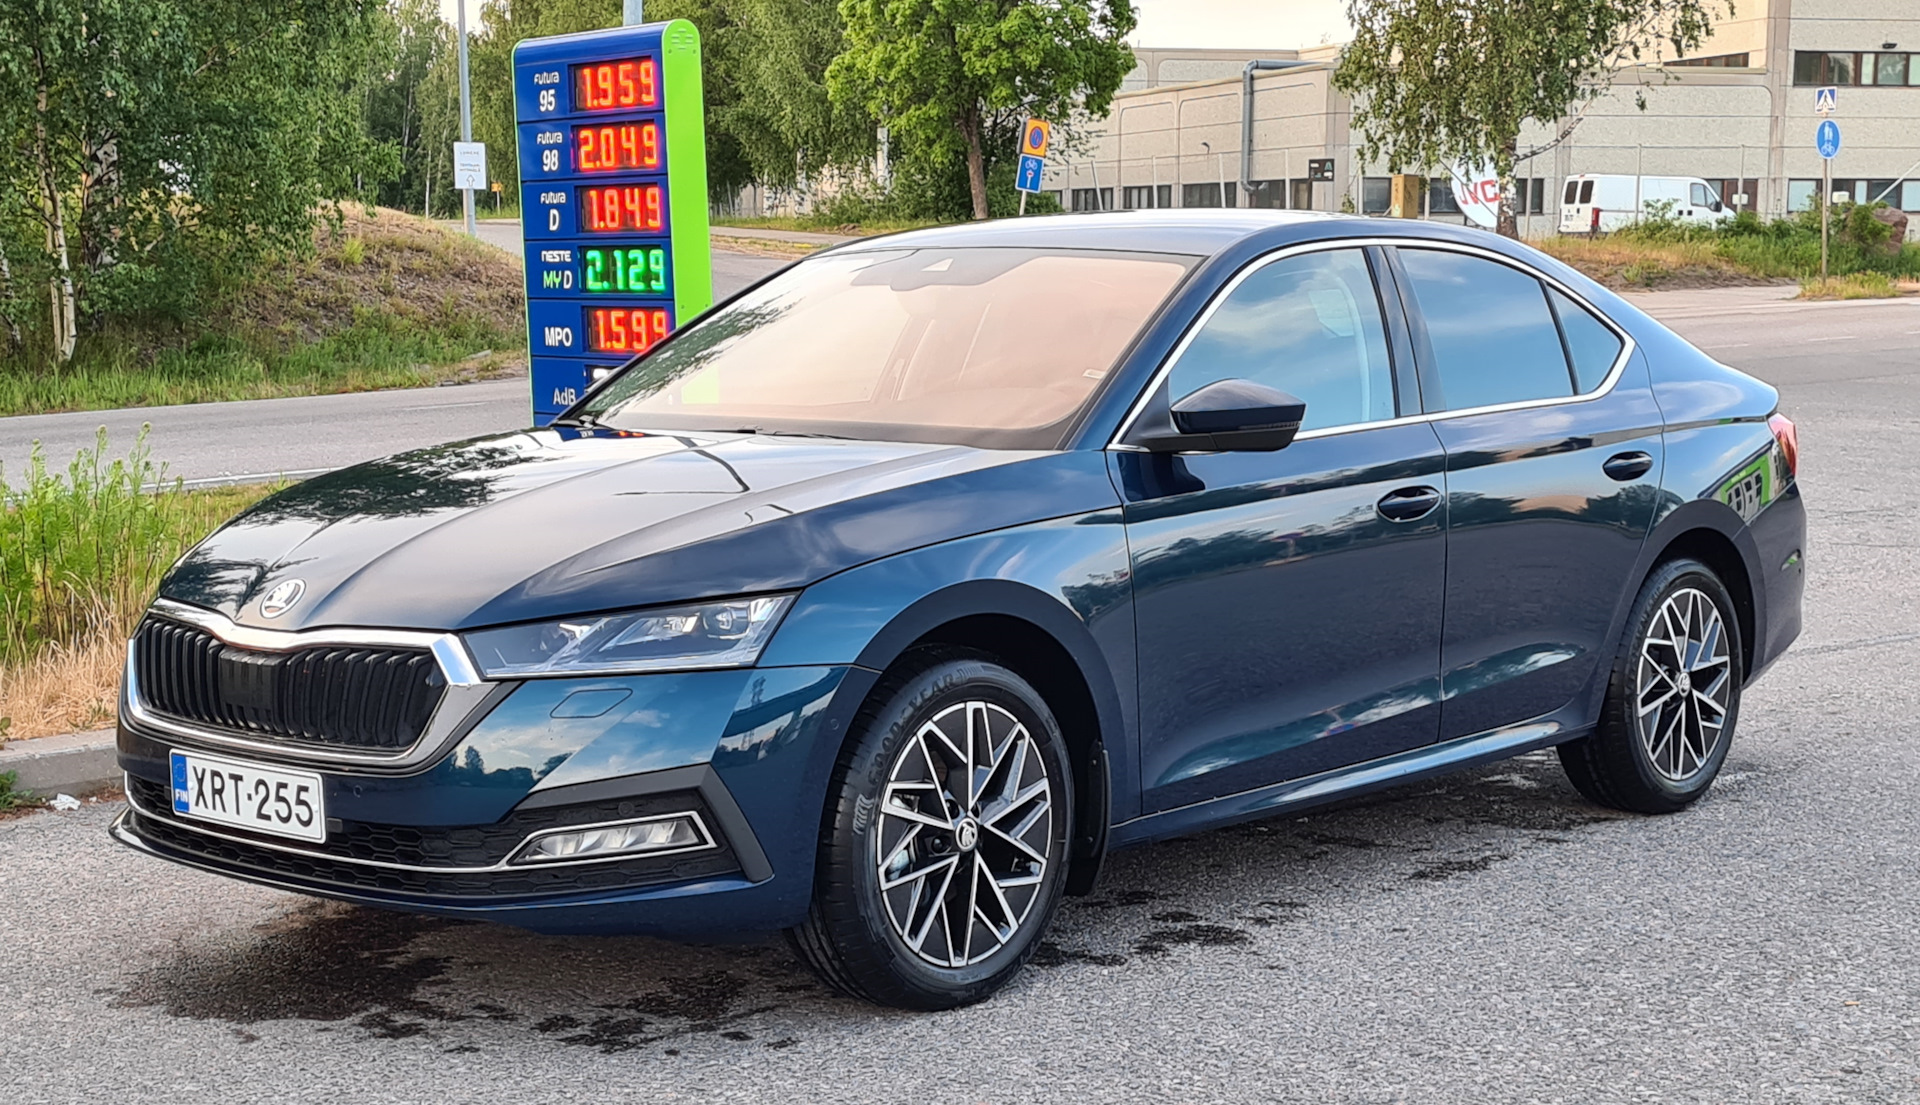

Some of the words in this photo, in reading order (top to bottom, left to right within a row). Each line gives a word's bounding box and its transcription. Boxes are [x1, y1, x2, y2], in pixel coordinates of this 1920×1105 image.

[582, 61, 656, 108] 1.959
[539, 89, 556, 112] 95
[579, 124, 658, 169] 2.049
[542, 149, 559, 172] 98
[588, 186, 662, 230] 1.849
[549, 209, 560, 231] D
[543, 271, 562, 288] MY
[563, 270, 573, 289] D
[586, 248, 666, 291] 2.129
[544, 326, 573, 347] MPO
[596, 310, 667, 350] 1.599
[175, 788, 189, 803] FIN
